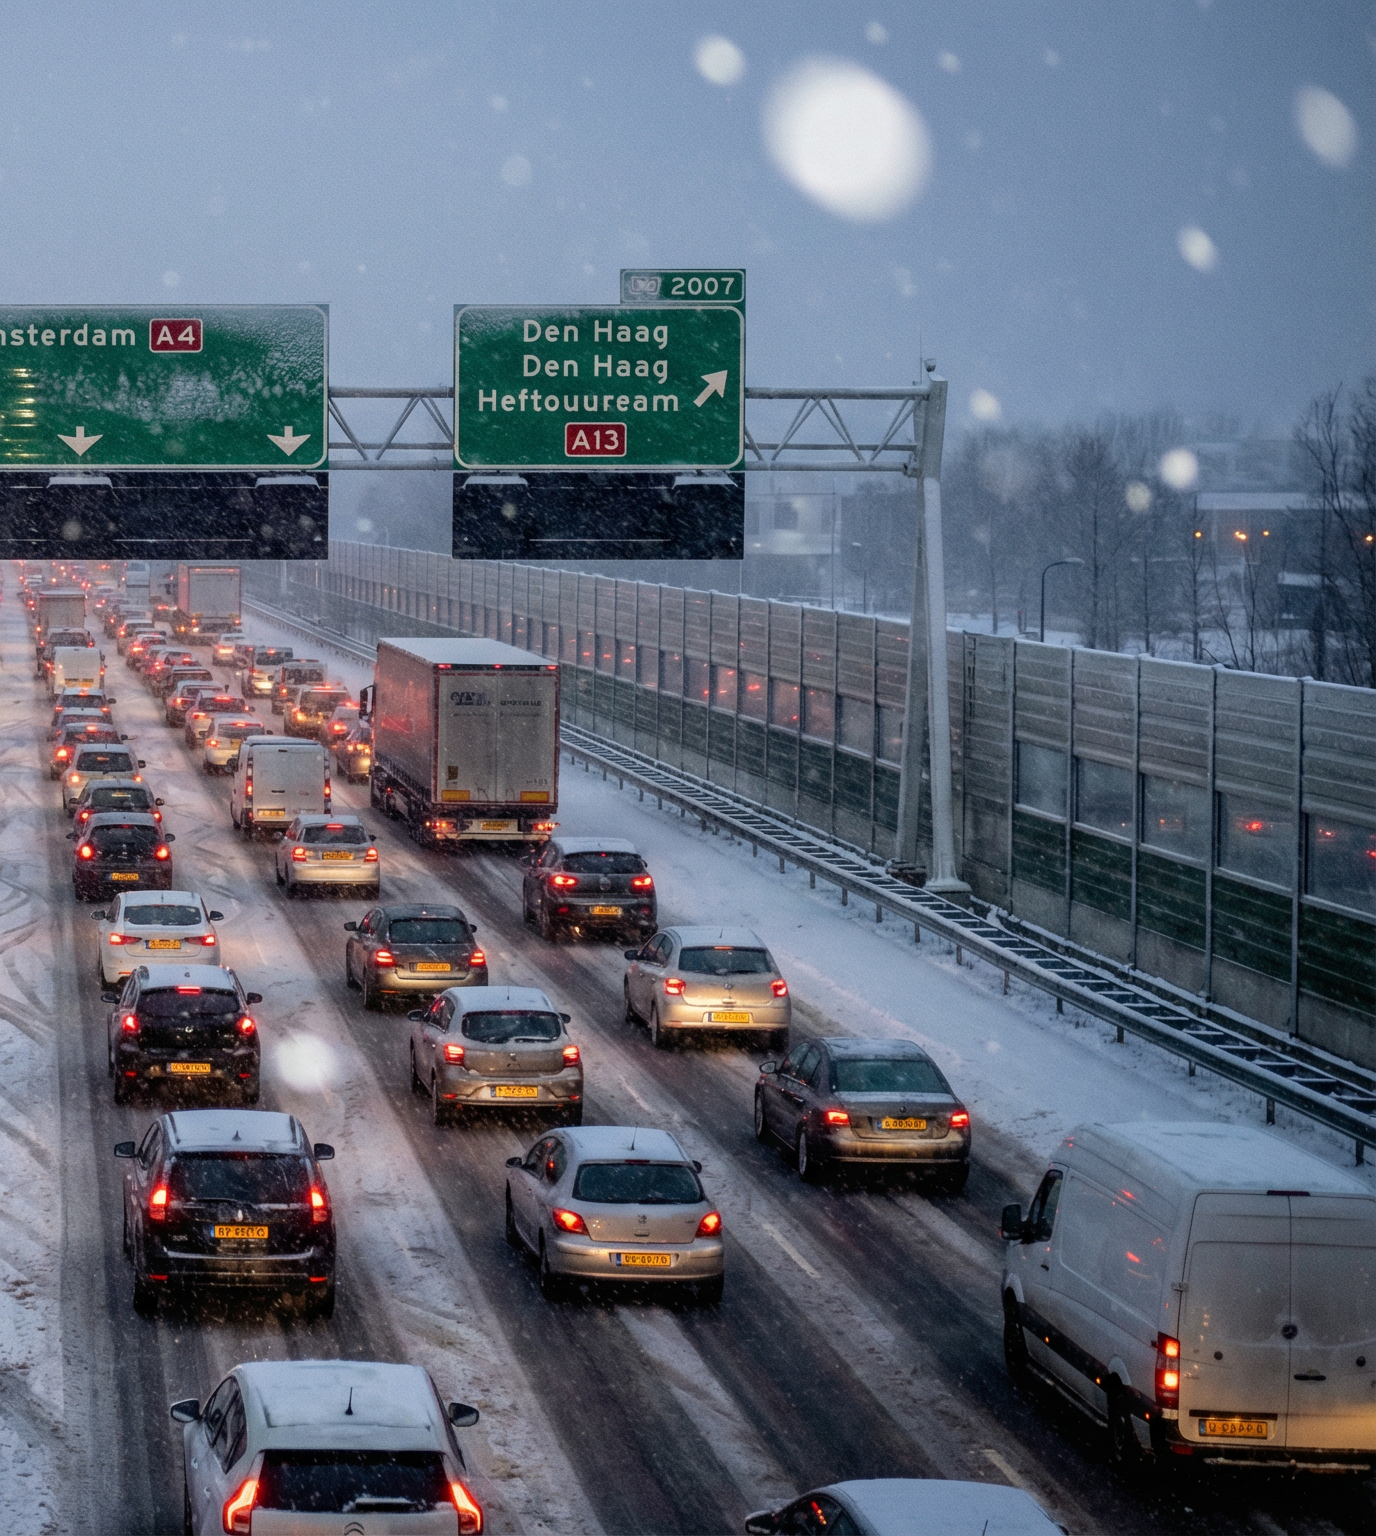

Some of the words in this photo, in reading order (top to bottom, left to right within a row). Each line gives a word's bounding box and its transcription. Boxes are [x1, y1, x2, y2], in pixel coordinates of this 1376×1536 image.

[672, 277, 735, 295] 2007
[156, 325, 196, 345] A4
[523, 319, 579, 343] Den
[594, 319, 668, 350] Haag
[523, 354, 579, 377] Den
[594, 354, 668, 385] Haag
[478, 388, 679, 412] Heftouuream
[571, 429, 619, 451] A13
